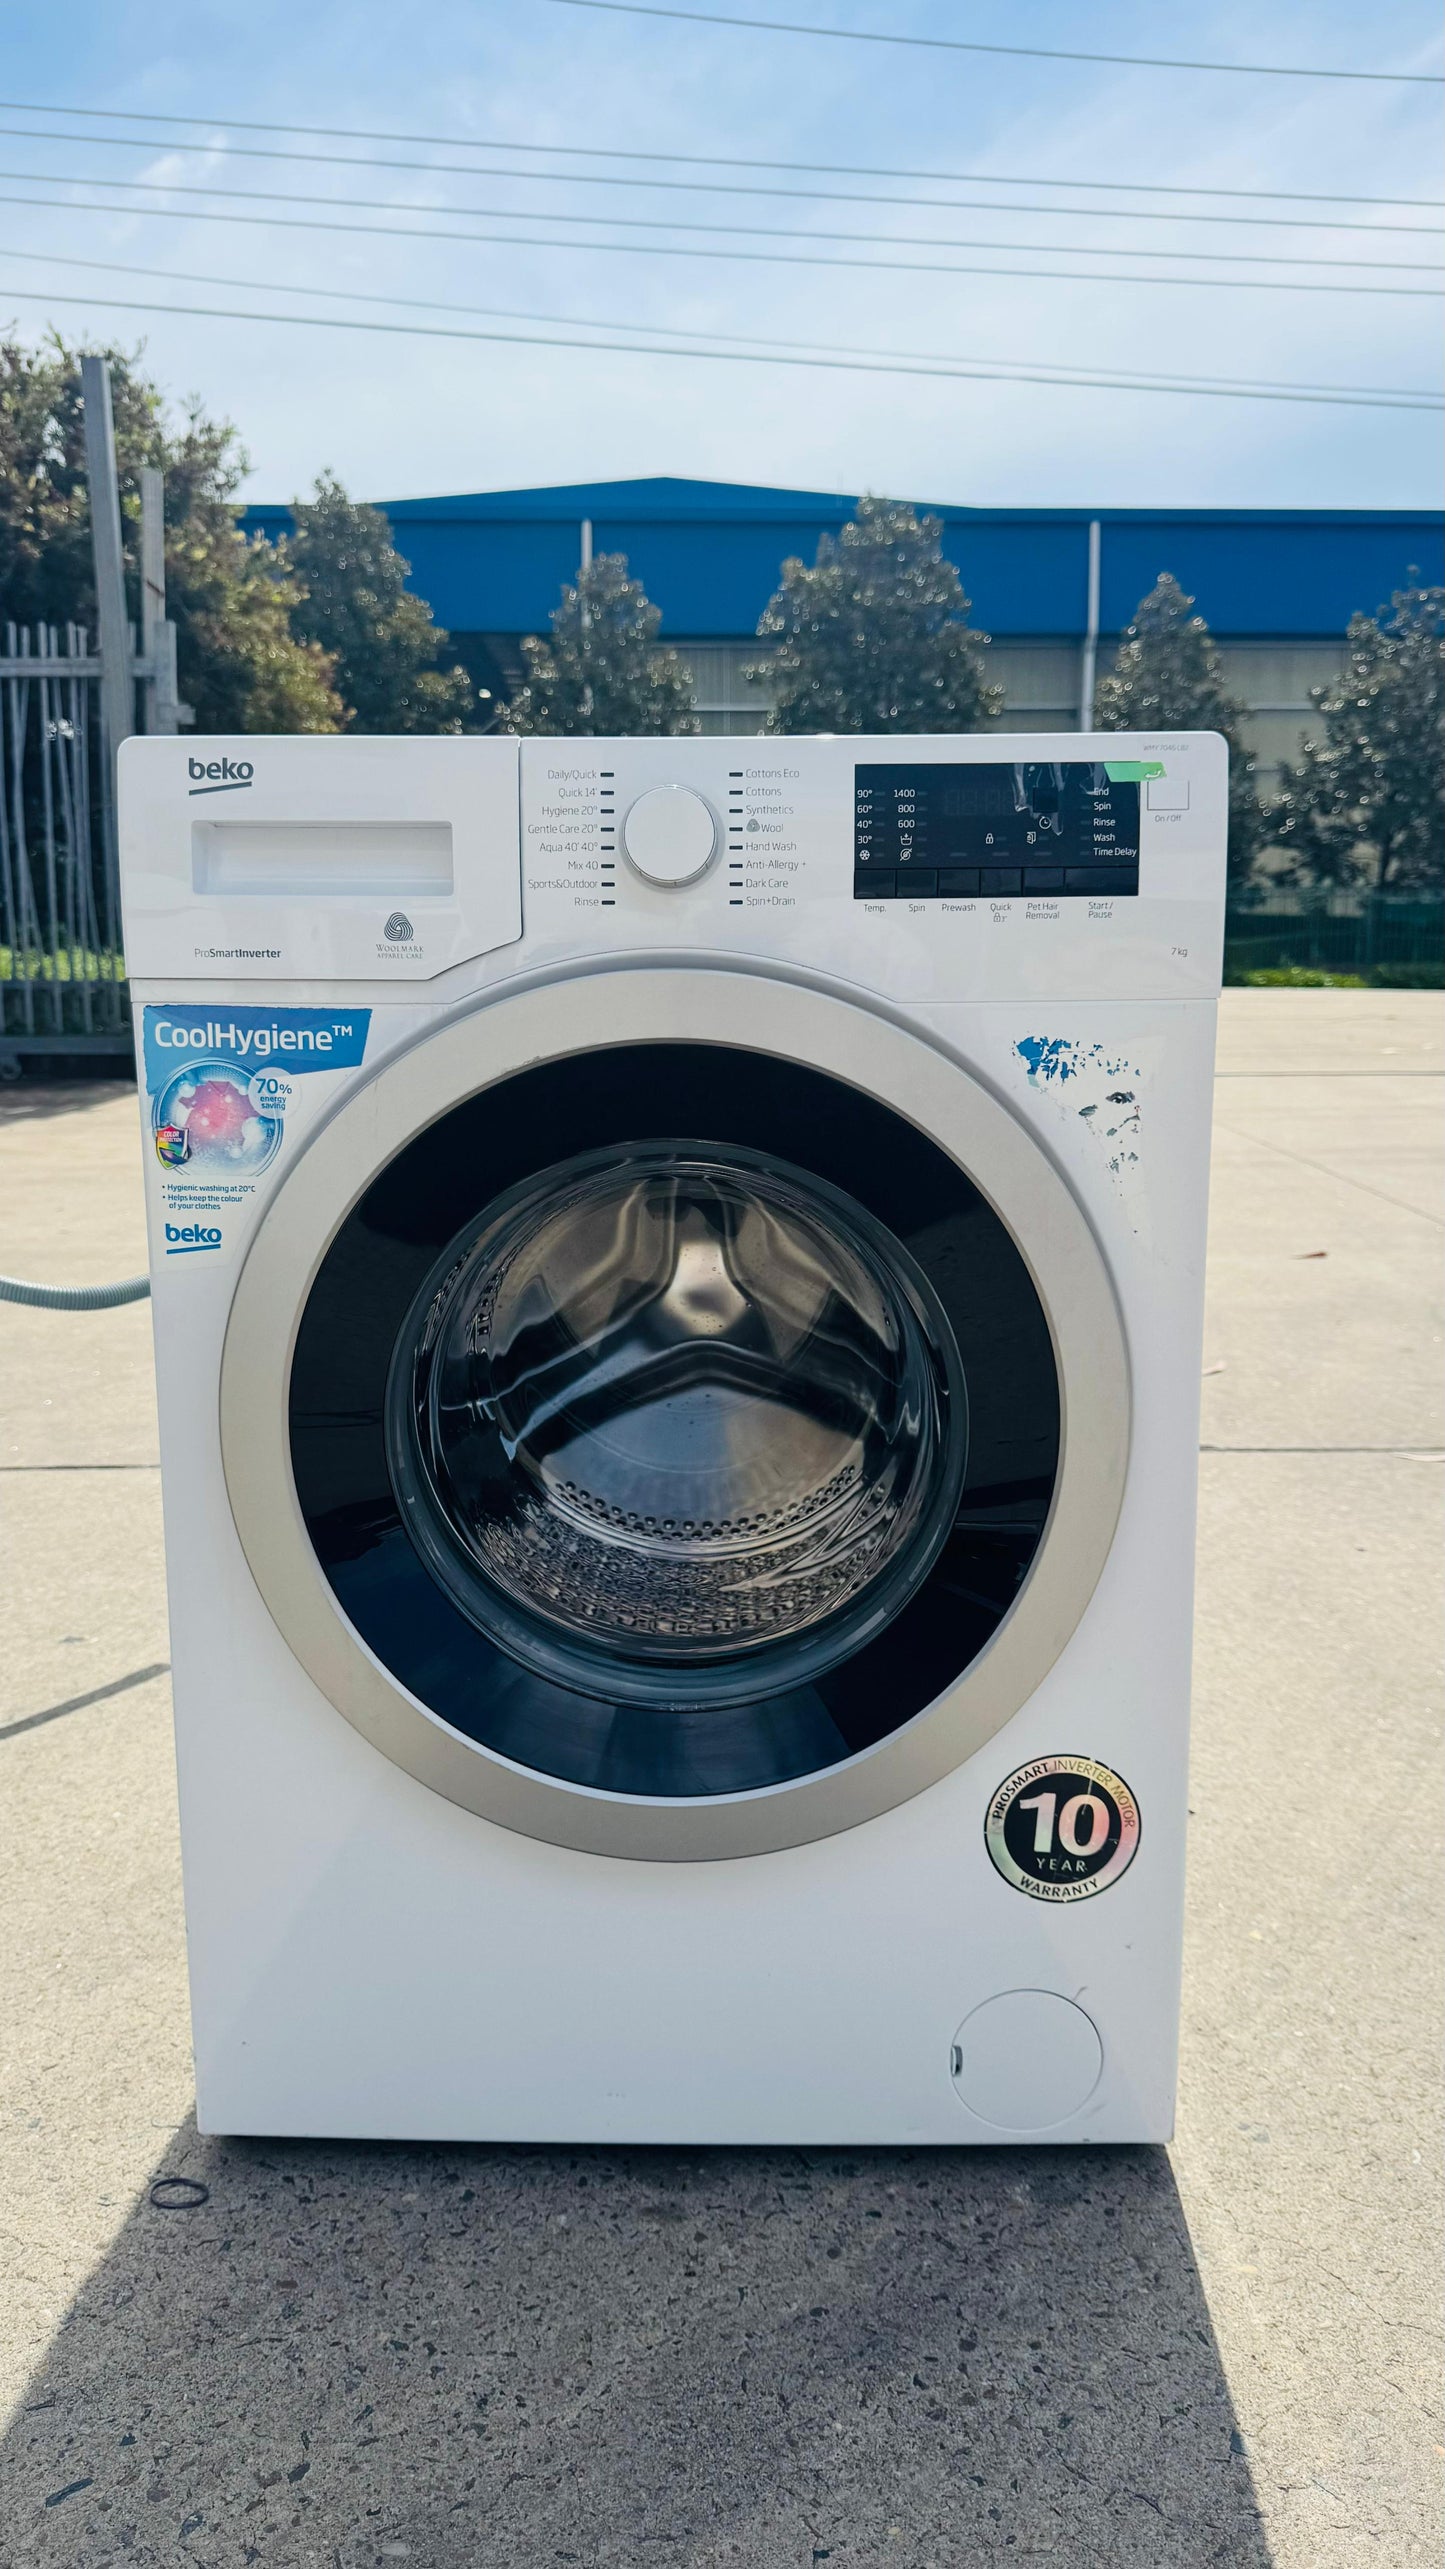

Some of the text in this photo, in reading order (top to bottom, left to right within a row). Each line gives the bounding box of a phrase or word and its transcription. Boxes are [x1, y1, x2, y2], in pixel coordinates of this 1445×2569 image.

[188, 758, 254, 780] beko
[746, 769, 799, 778] Cottons Eco
[548, 770, 596, 781] Daily/Quick
[559, 788, 582, 798] Quick
[746, 787, 782, 796] Cottons
[857, 790, 872, 798] 90°
[894, 789, 915, 797] 1400
[1094, 788, 1109, 796] End
[746, 805, 794, 816] Synthetics
[857, 805, 872, 813] 60°
[898, 805, 915, 813] 800
[1094, 802, 1111, 811] Spin
[542, 806, 579, 817] Hygiene
[857, 820, 872, 828] 40°
[898, 820, 915, 828] 600
[1094, 818, 1115, 826] Rinse
[528, 825, 557, 833] Gentle
[559, 825, 579, 833] Care
[761, 824, 783, 832] Wool
[540, 843, 562, 853] Aqua
[746, 842, 796, 851] Hand Wash
[1094, 848, 1137, 857] Time Delay
[568, 861, 598, 870] Mix 40
[746, 860, 798, 871] Anti-Allergy
[528, 880, 598, 890] Sports&Outdoor
[746, 879, 788, 888] Dark Care
[575, 897, 599, 906] Rinse
[746, 896, 795, 906] Spin+Drain
[864, 904, 886, 912] Temp.
[909, 904, 925, 913] Spin
[942, 904, 976, 912] Prewash
[990, 903, 1011, 912] Quick
[1043, 902, 1058, 910] Hair
[376, 944, 424, 952] WOOLMARK
[1178, 948, 1188, 957] kg
[194, 948, 281, 960] ProSmartInverter
[256, 1078, 292, 1095] 70%
[260, 1096, 286, 1104] energy
[261, 1102, 286, 1111] saving
[167, 1184, 198, 1192] Hygienic
[200, 1185, 229, 1193] washing
[165, 1223, 222, 1243] beko
[992, 1760, 1136, 1828] PROSMART INVERTER MOTOR
[1019, 1792, 1110, 1857] 10
[1036, 1857, 1088, 1872] YEAR
[1020, 1875, 1099, 1897] WARRANTY
